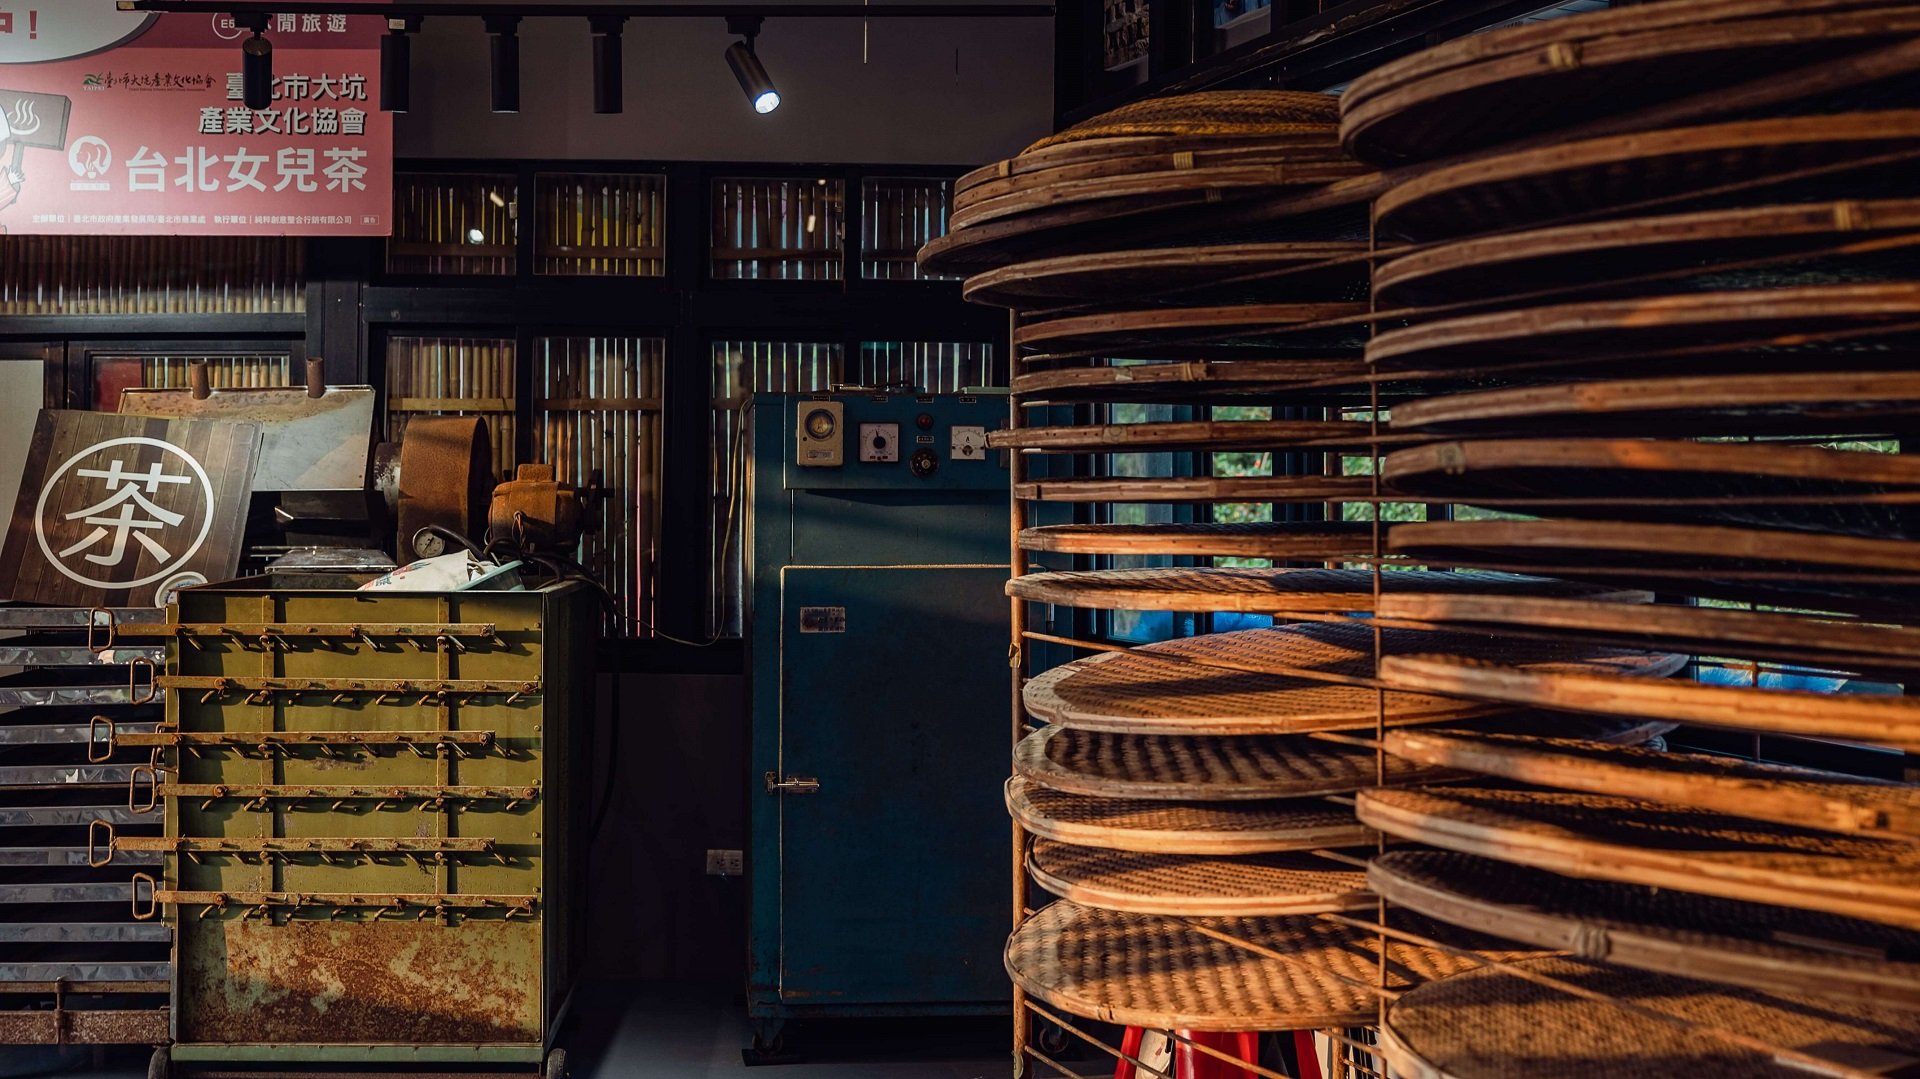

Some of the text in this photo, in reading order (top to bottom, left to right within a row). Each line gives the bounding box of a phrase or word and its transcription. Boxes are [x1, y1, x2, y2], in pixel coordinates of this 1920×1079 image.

[267, 13, 346, 33] 閒旅遊
[198, 106, 366, 135] 產業文化協會
[125, 146, 368, 193] 台北女兒茶
[59, 459, 192, 566] 茶
